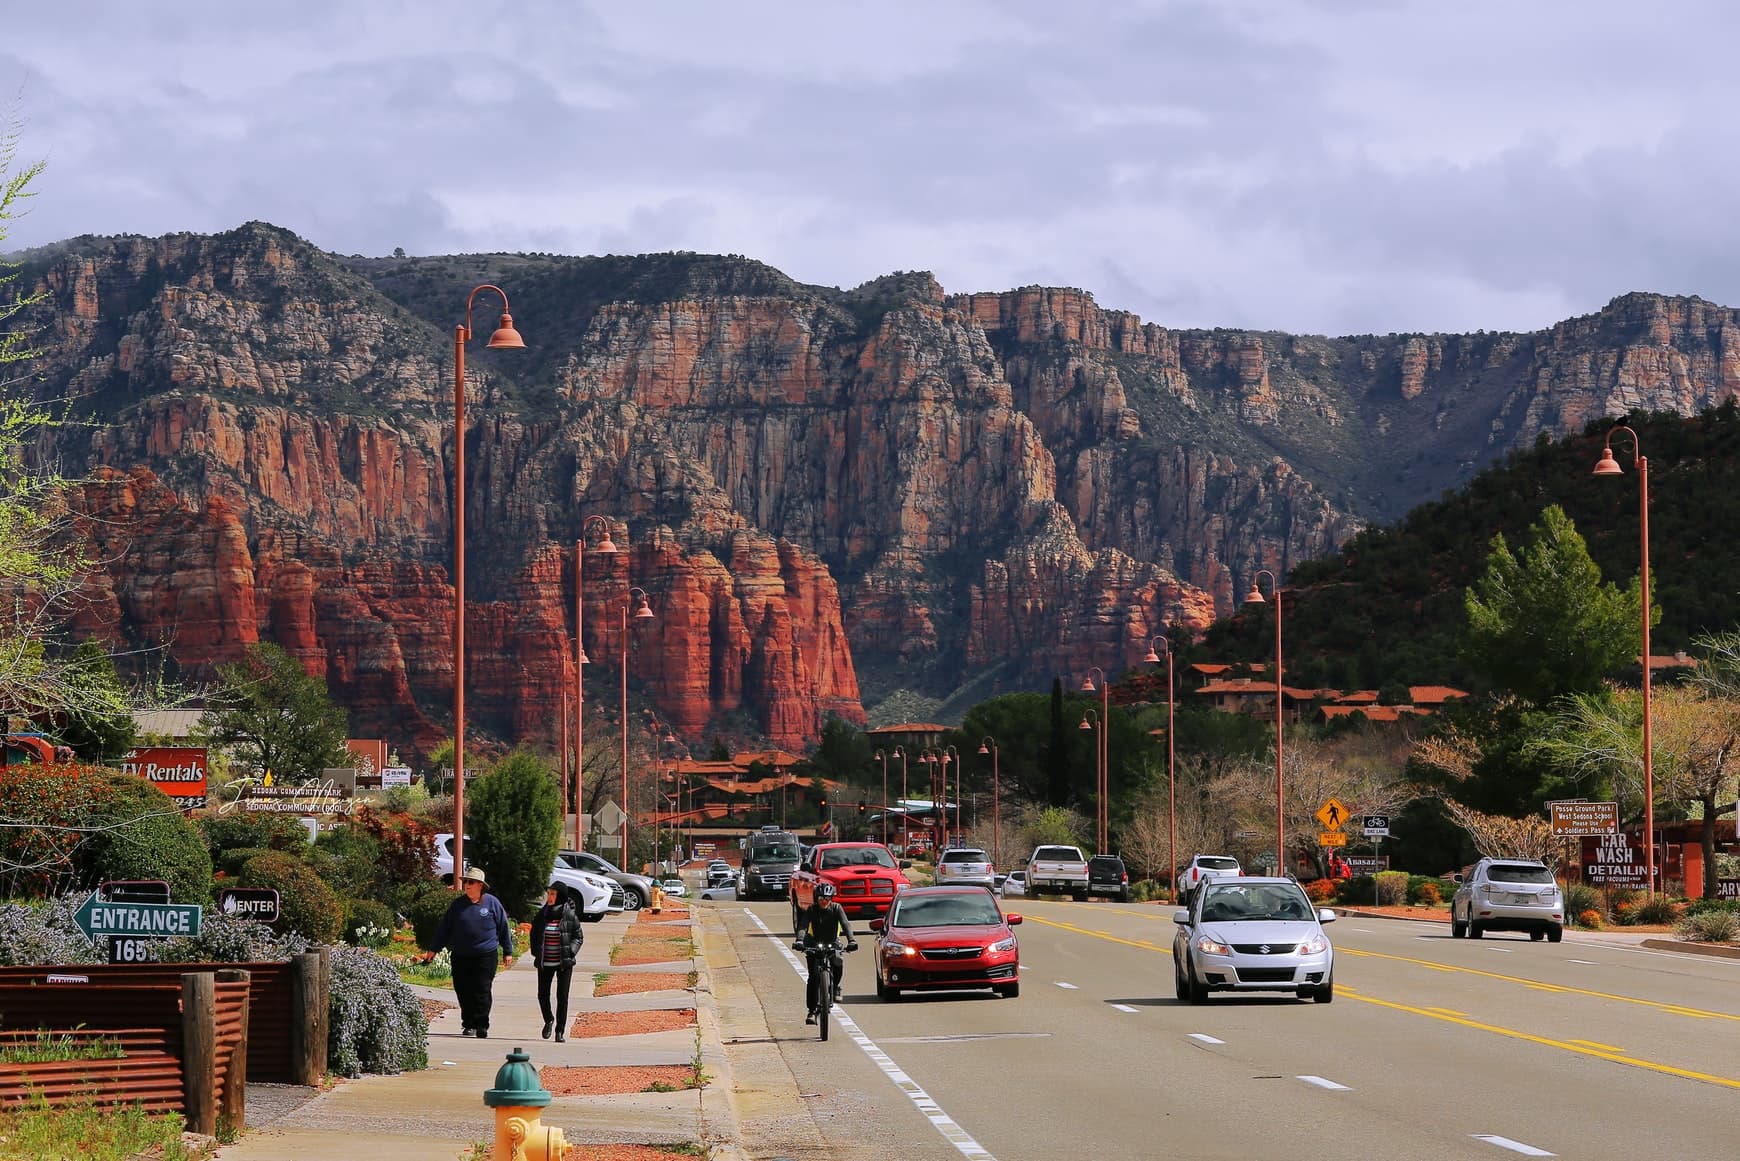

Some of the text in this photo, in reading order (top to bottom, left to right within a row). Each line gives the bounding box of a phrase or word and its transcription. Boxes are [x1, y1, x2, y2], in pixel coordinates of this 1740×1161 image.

[145, 761, 203, 781] Rentals
[251, 787, 277, 795] SEDONA
[280, 788, 322, 796] COMMUNITY
[246, 803, 273, 812] SEDONA
[277, 804, 320, 812] COMMUNITY
[1601, 833, 1627, 848] CAR
[1345, 857, 1377, 866] Anasaz
[1595, 847, 1633, 863] WASH
[236, 900, 274, 913] ENTER
[90, 908, 190, 932] ENTRANCE
